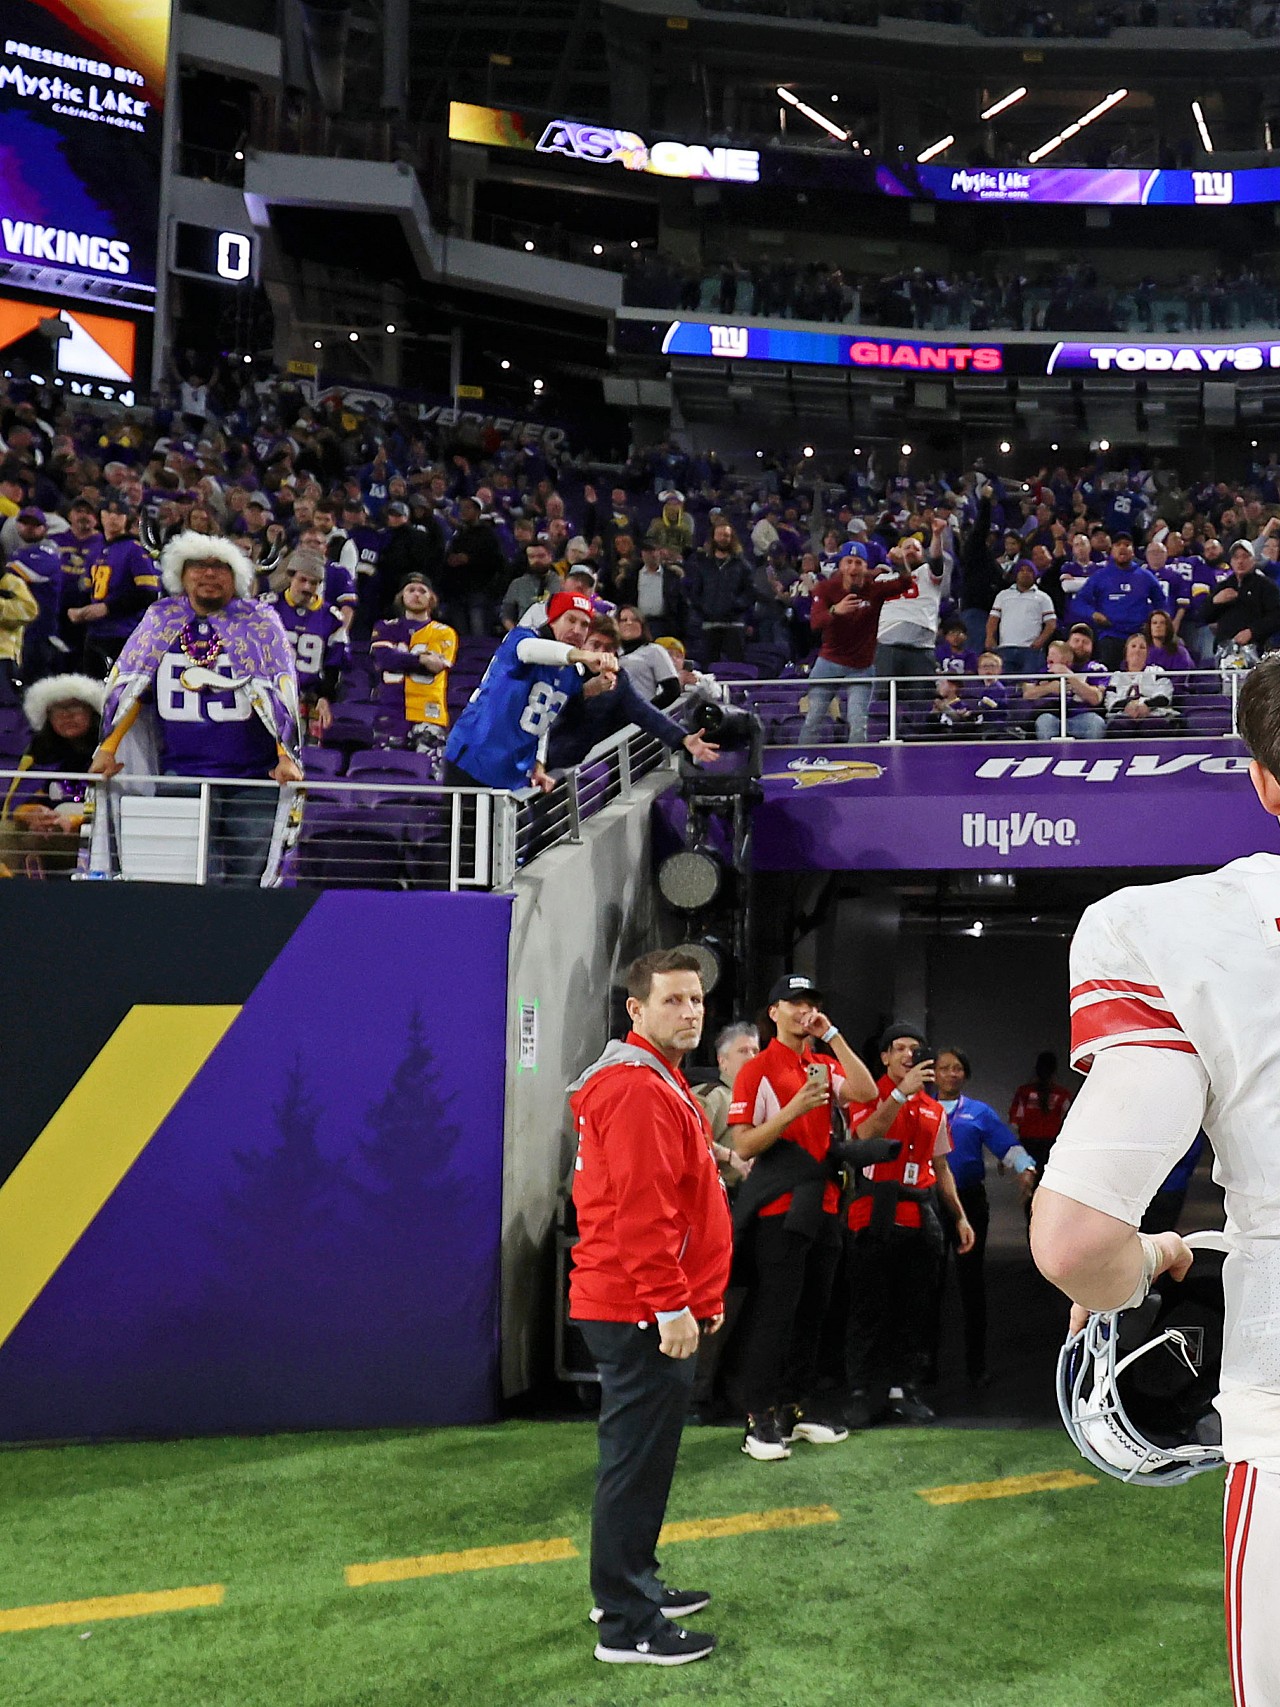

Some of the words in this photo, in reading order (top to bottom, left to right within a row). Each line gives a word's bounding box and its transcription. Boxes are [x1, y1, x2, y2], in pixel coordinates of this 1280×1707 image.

[5, 40, 112, 78] PRESENTED
[650, 141, 760, 183] ONE
[2, 218, 130, 275] VIKINGS
[217, 232, 250, 280] 0
[849, 341, 1002, 372] GIANTS
[1089, 343, 1263, 372] TODAY'S
[974, 753, 1251, 783] HyVe
[961, 811, 1078, 855] HyVee
